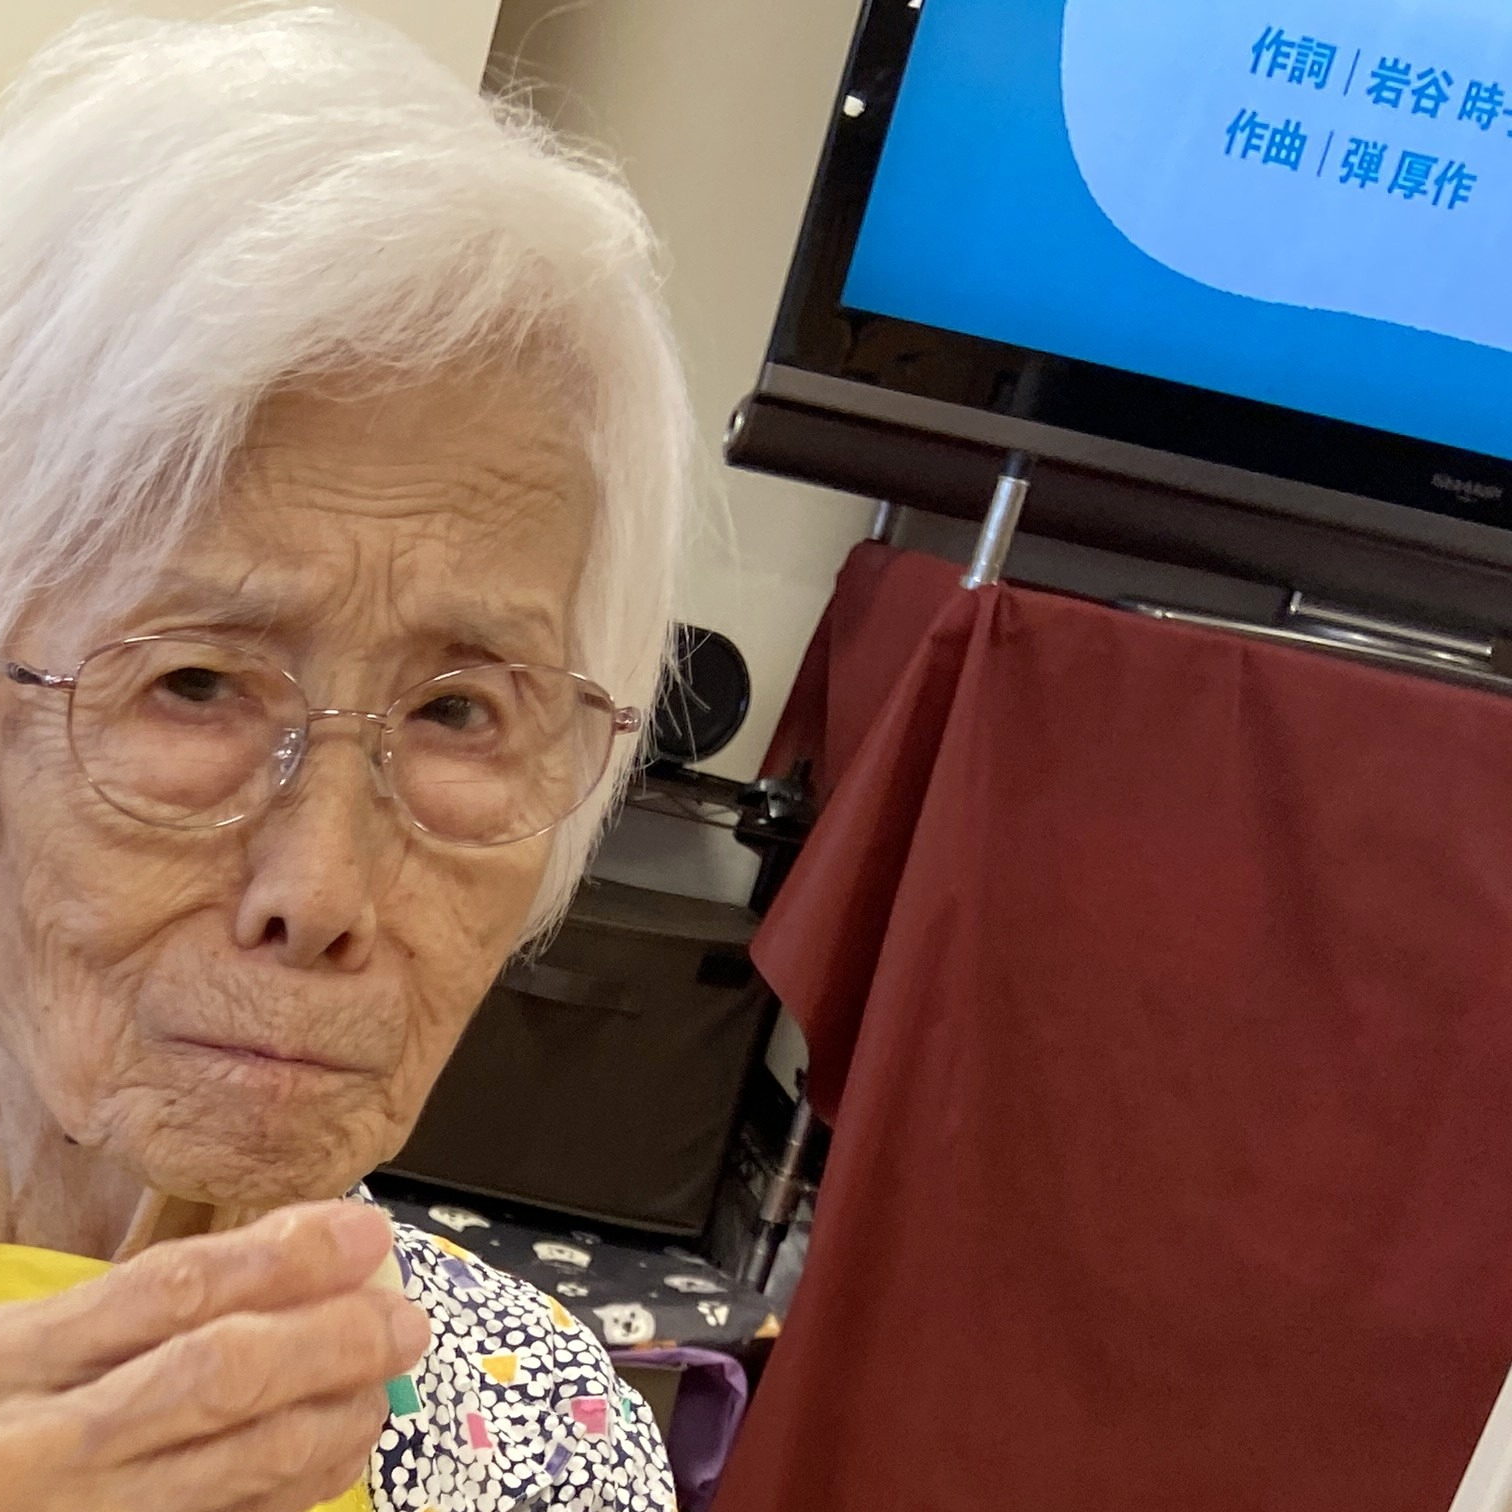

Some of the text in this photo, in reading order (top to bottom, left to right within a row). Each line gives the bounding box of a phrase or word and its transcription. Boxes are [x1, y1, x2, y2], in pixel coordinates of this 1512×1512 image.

[1249, 25, 1337, 90] 作詞
[1366, 56, 1454, 118] 岩谷
[1224, 107, 1307, 172] 作曲
